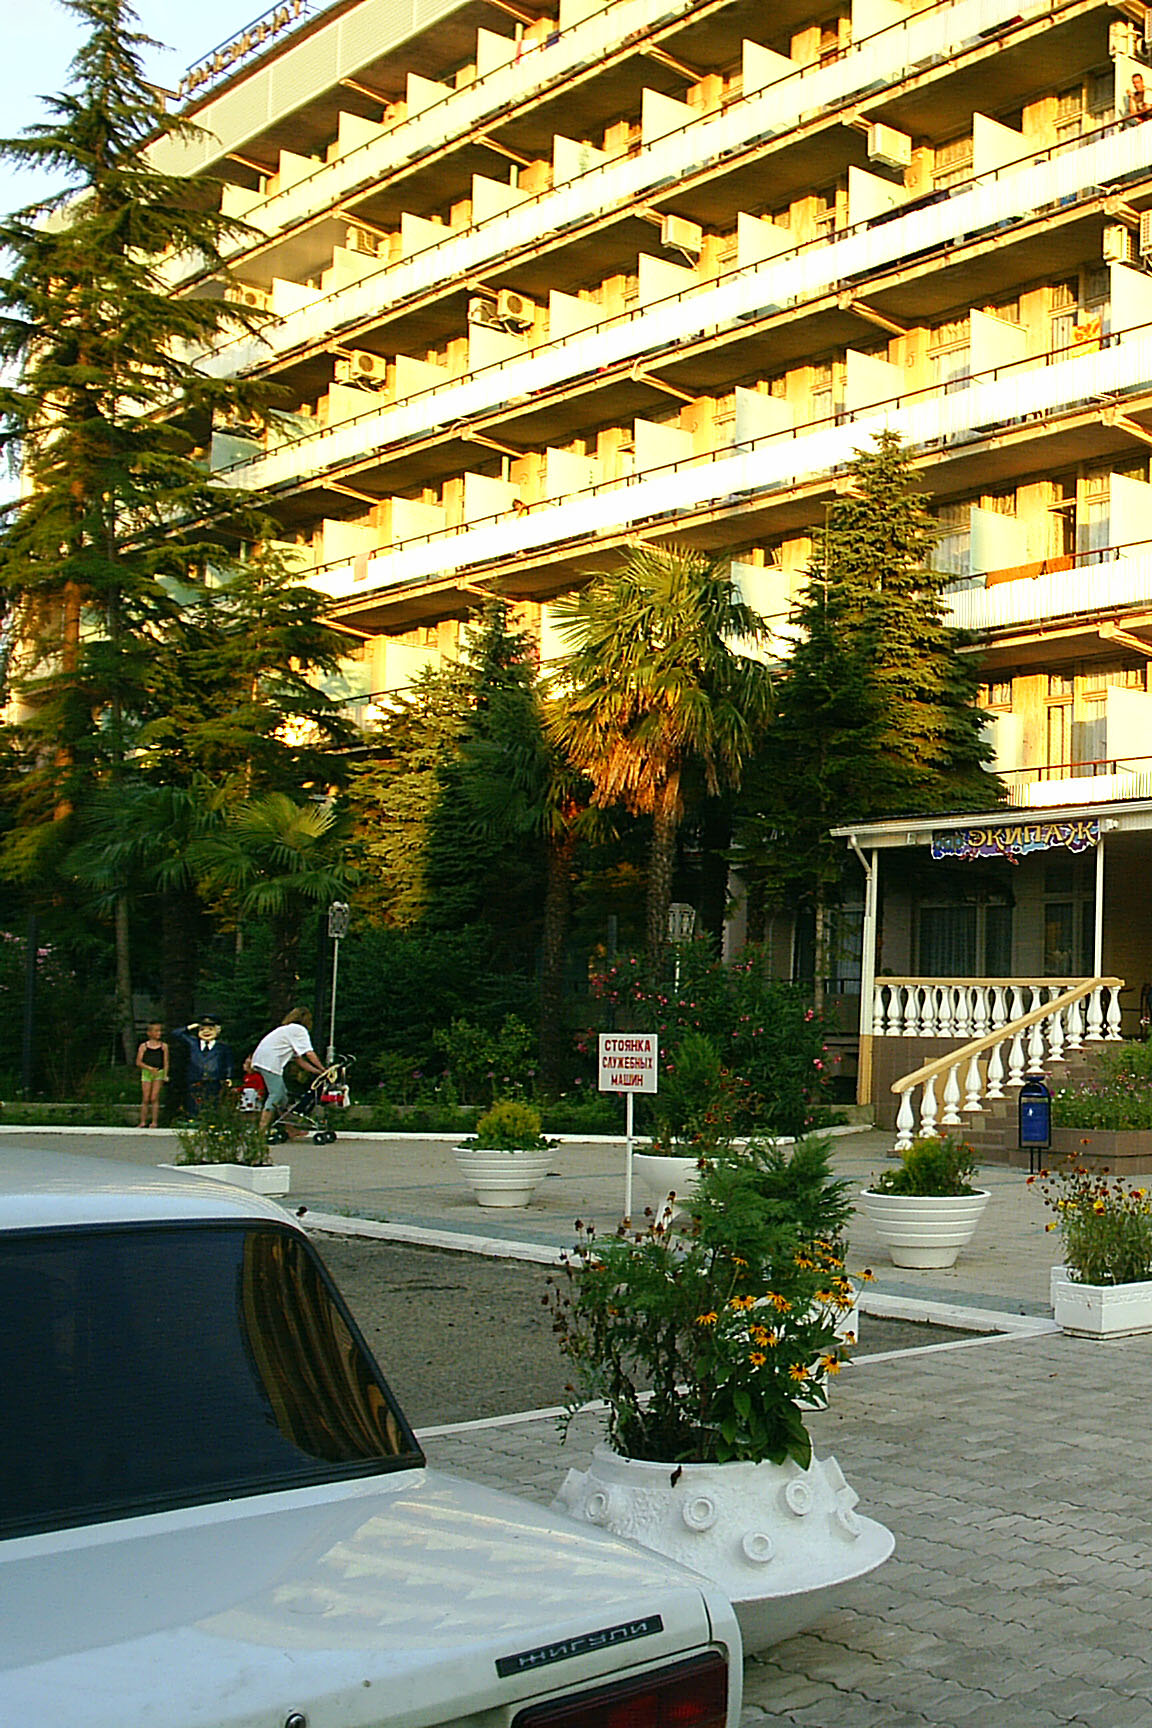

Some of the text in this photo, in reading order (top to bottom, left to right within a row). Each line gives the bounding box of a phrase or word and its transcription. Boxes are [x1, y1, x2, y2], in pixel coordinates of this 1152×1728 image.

[968, 821, 1097, 850] ЭКИПАЖ
[604, 1039, 651, 1052] СТОЯНКА
[602, 1056, 653, 1069] СЛУЖЕБНЫХ
[611, 1073, 644, 1087] МАШИН
[518, 1621, 648, 1667] ЖИГУЛИ
